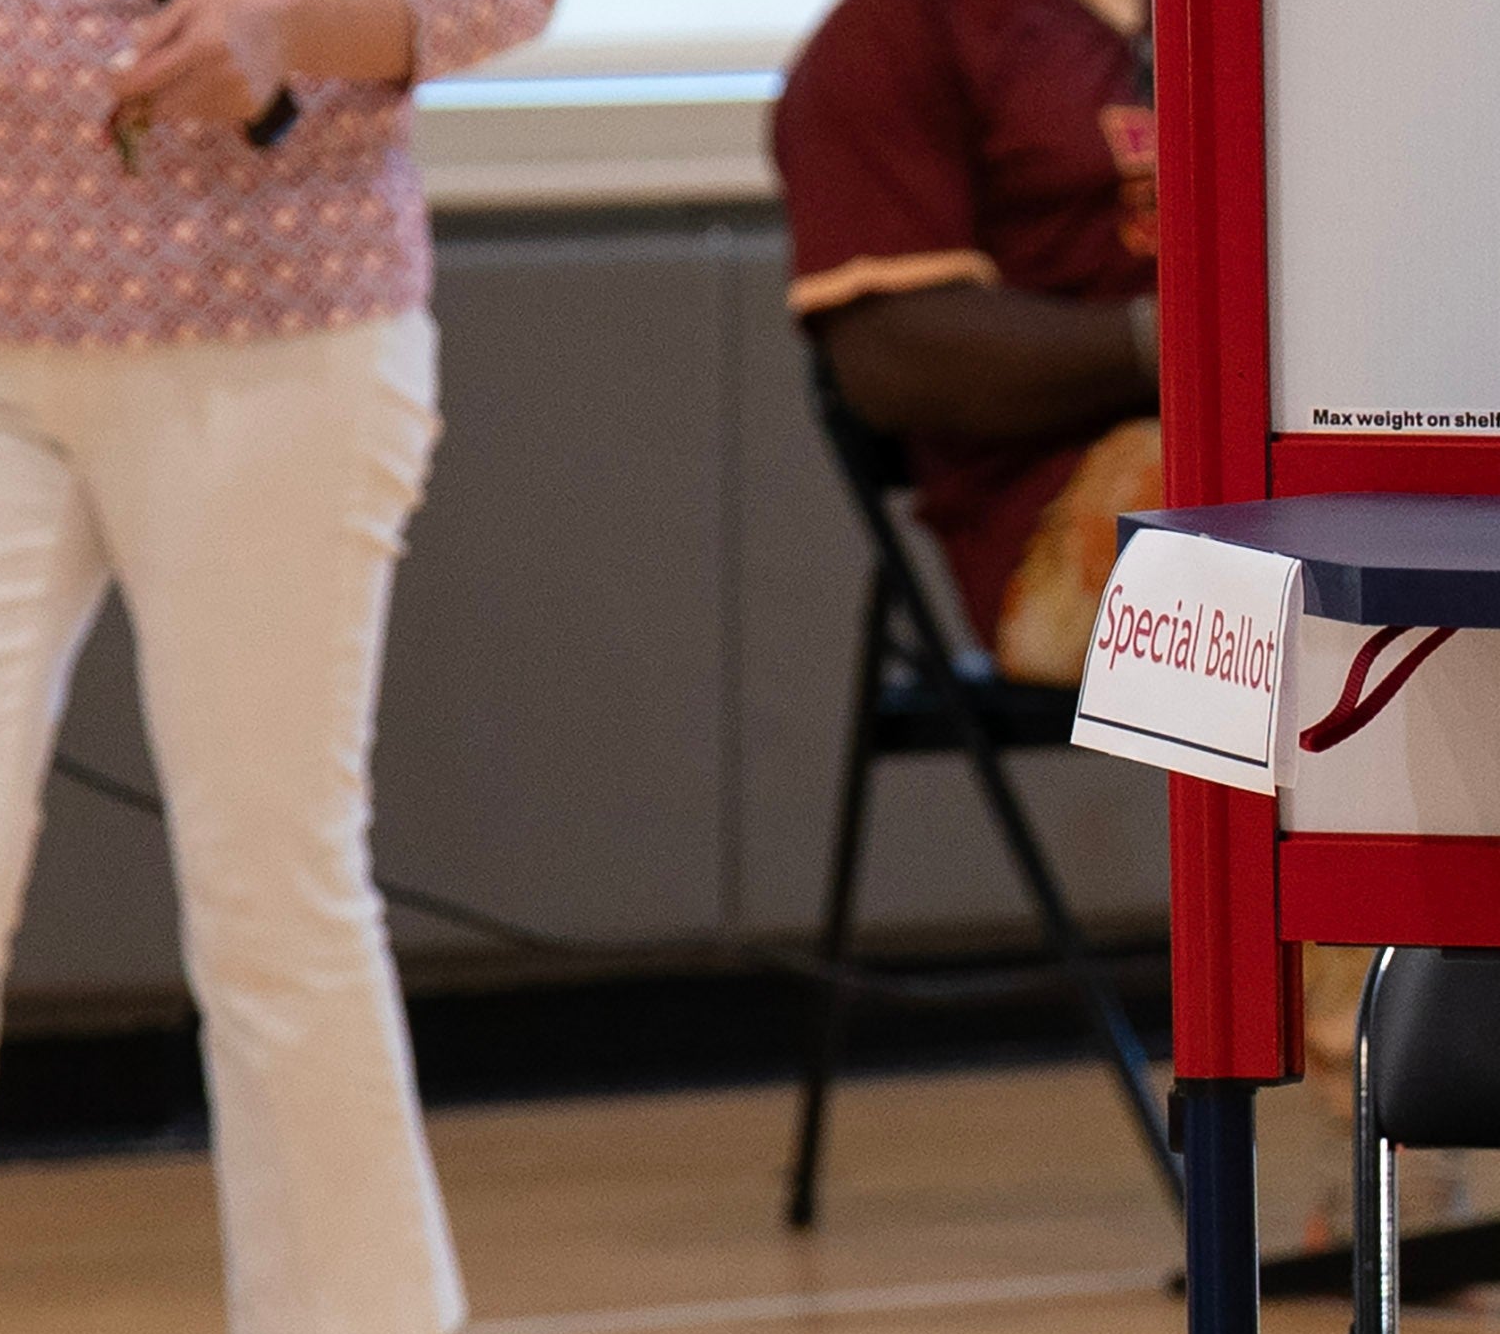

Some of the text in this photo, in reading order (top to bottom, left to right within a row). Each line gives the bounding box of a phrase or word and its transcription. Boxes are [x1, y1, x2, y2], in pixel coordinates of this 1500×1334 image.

[1313, 411, 1352, 426] Max
[1357, 410, 1423, 430] weight
[1427, 414, 1450, 427] on
[1098, 584, 1274, 693] Special Ballot
